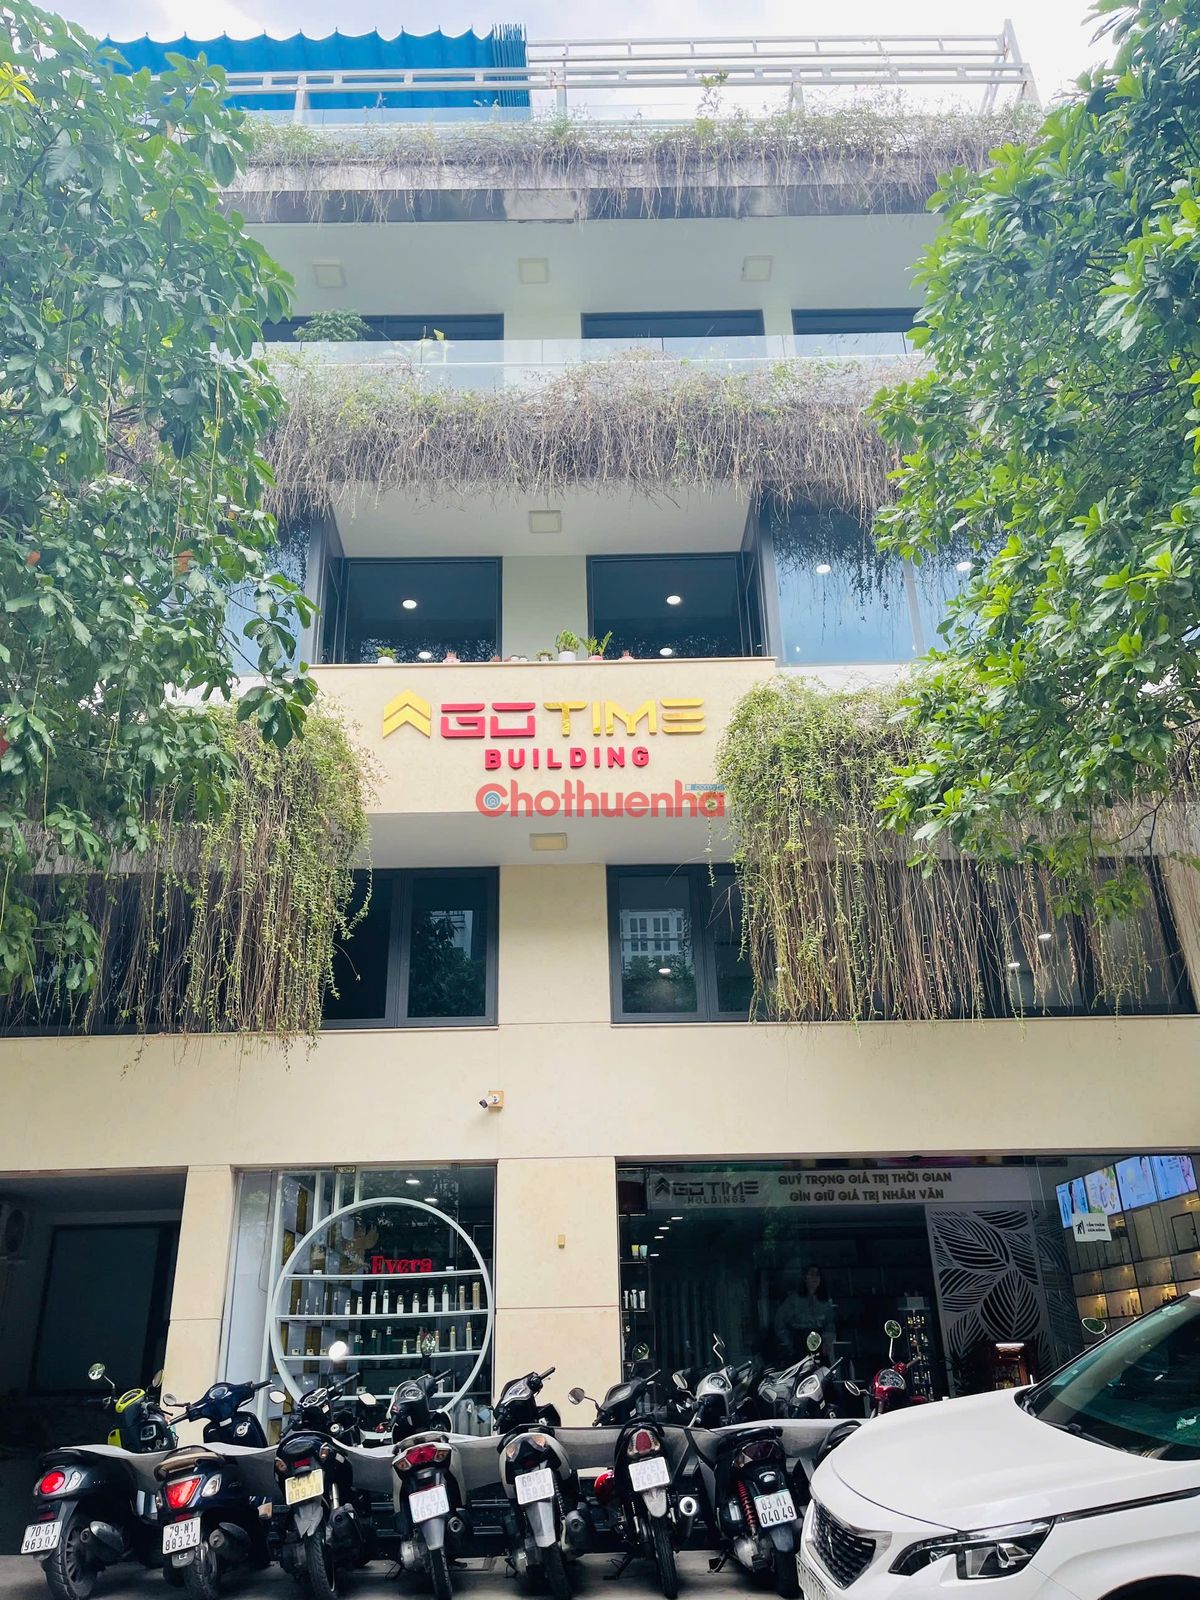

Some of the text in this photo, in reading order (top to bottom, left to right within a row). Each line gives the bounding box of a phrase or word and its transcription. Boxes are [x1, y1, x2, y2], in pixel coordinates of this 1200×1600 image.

[485, 746, 650, 770] BUILDING
[805, 1174, 845, 1188] TRỌNG
[848, 1172, 870, 1185] GIÁ
[872, 1173, 890, 1186] TRỊ
[891, 1171, 920, 1184] THỜI
[922, 1172, 953, 1183] GIAN
[687, 1195, 747, 1205] HOLDINGS
[838, 1189, 860, 1201] GIÁ
[862, 1191, 880, 1203] TRỊ
[882, 1188, 916, 1200] NHÂN
[164, 1533, 198, 1551] 883.24
